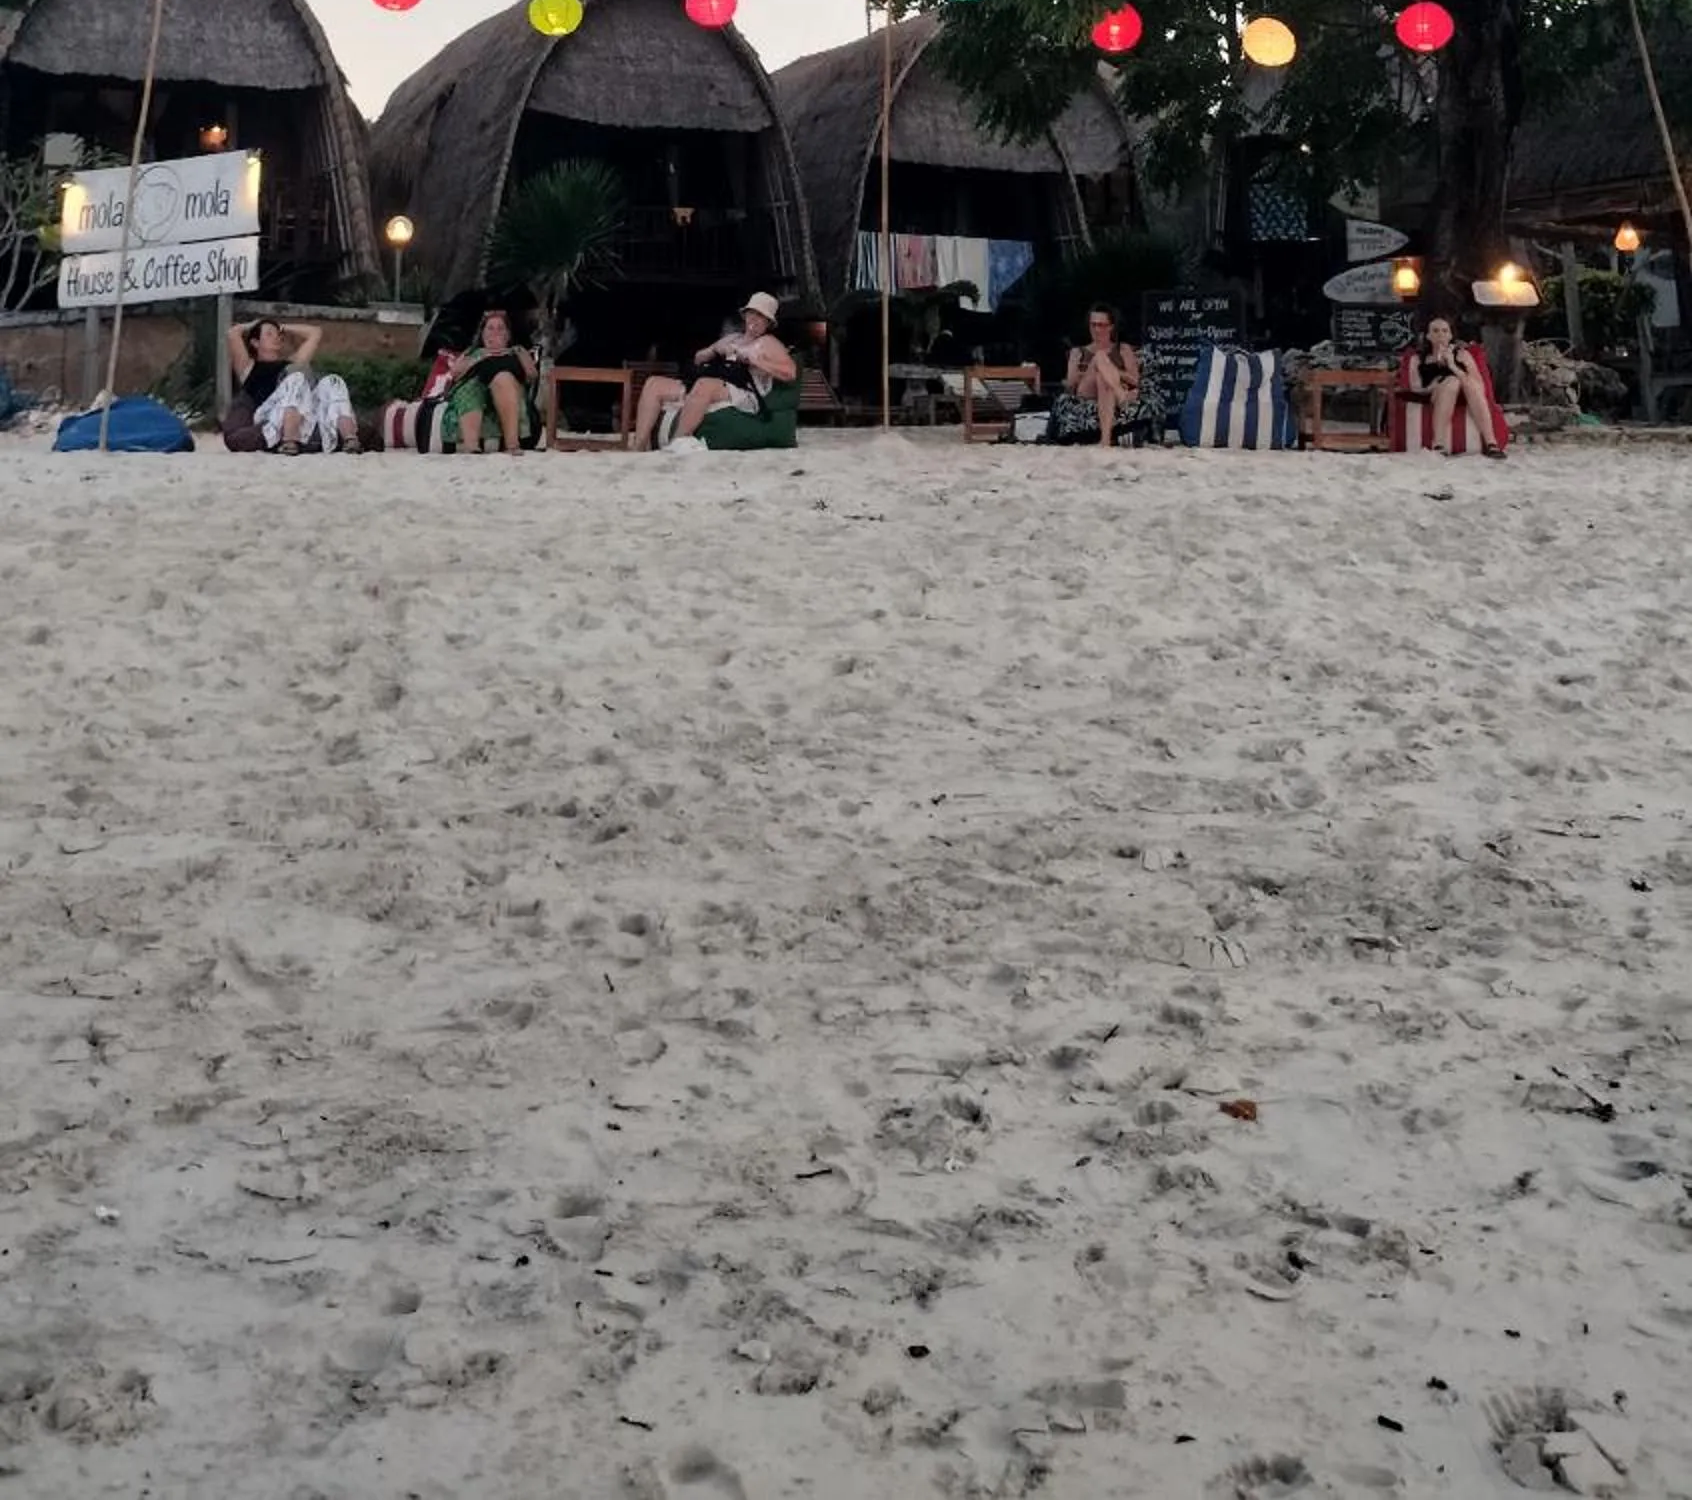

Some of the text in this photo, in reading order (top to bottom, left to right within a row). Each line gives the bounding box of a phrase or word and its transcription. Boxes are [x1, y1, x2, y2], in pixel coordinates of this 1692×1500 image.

[79, 179, 231, 231] mola mola
[67, 248, 248, 297] House & Coffee Shop
[1179, 299, 1197, 312] ARE
[1202, 298, 1229, 311] OPEN
